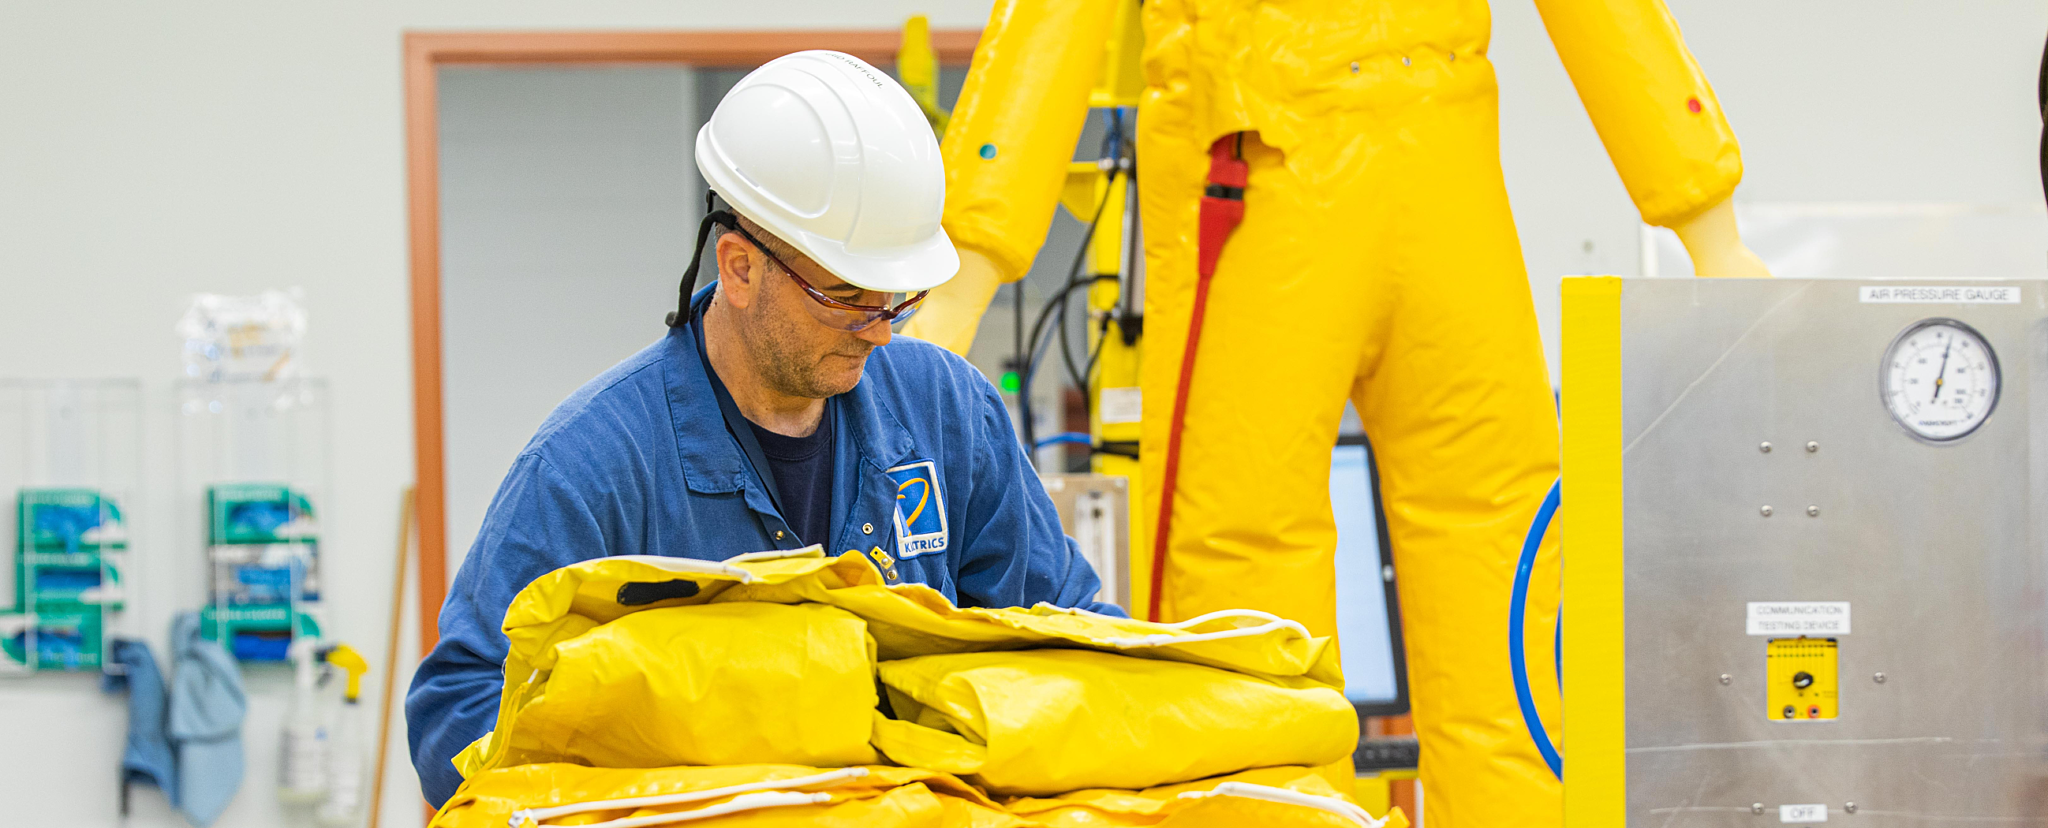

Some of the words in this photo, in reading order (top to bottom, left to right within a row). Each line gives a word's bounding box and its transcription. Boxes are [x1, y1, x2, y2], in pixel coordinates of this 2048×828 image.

[1869, 289, 1890, 300] AIR
[1894, 289, 1961, 300] PRESSURE
[1965, 289, 2010, 300] GAUGE
[1756, 606, 1843, 615] COMMUNICATION
[1758, 621, 1800, 630] TESTING
[1804, 621, 1839, 630] DEVICE
[1790, 807, 1816, 819] OFF
